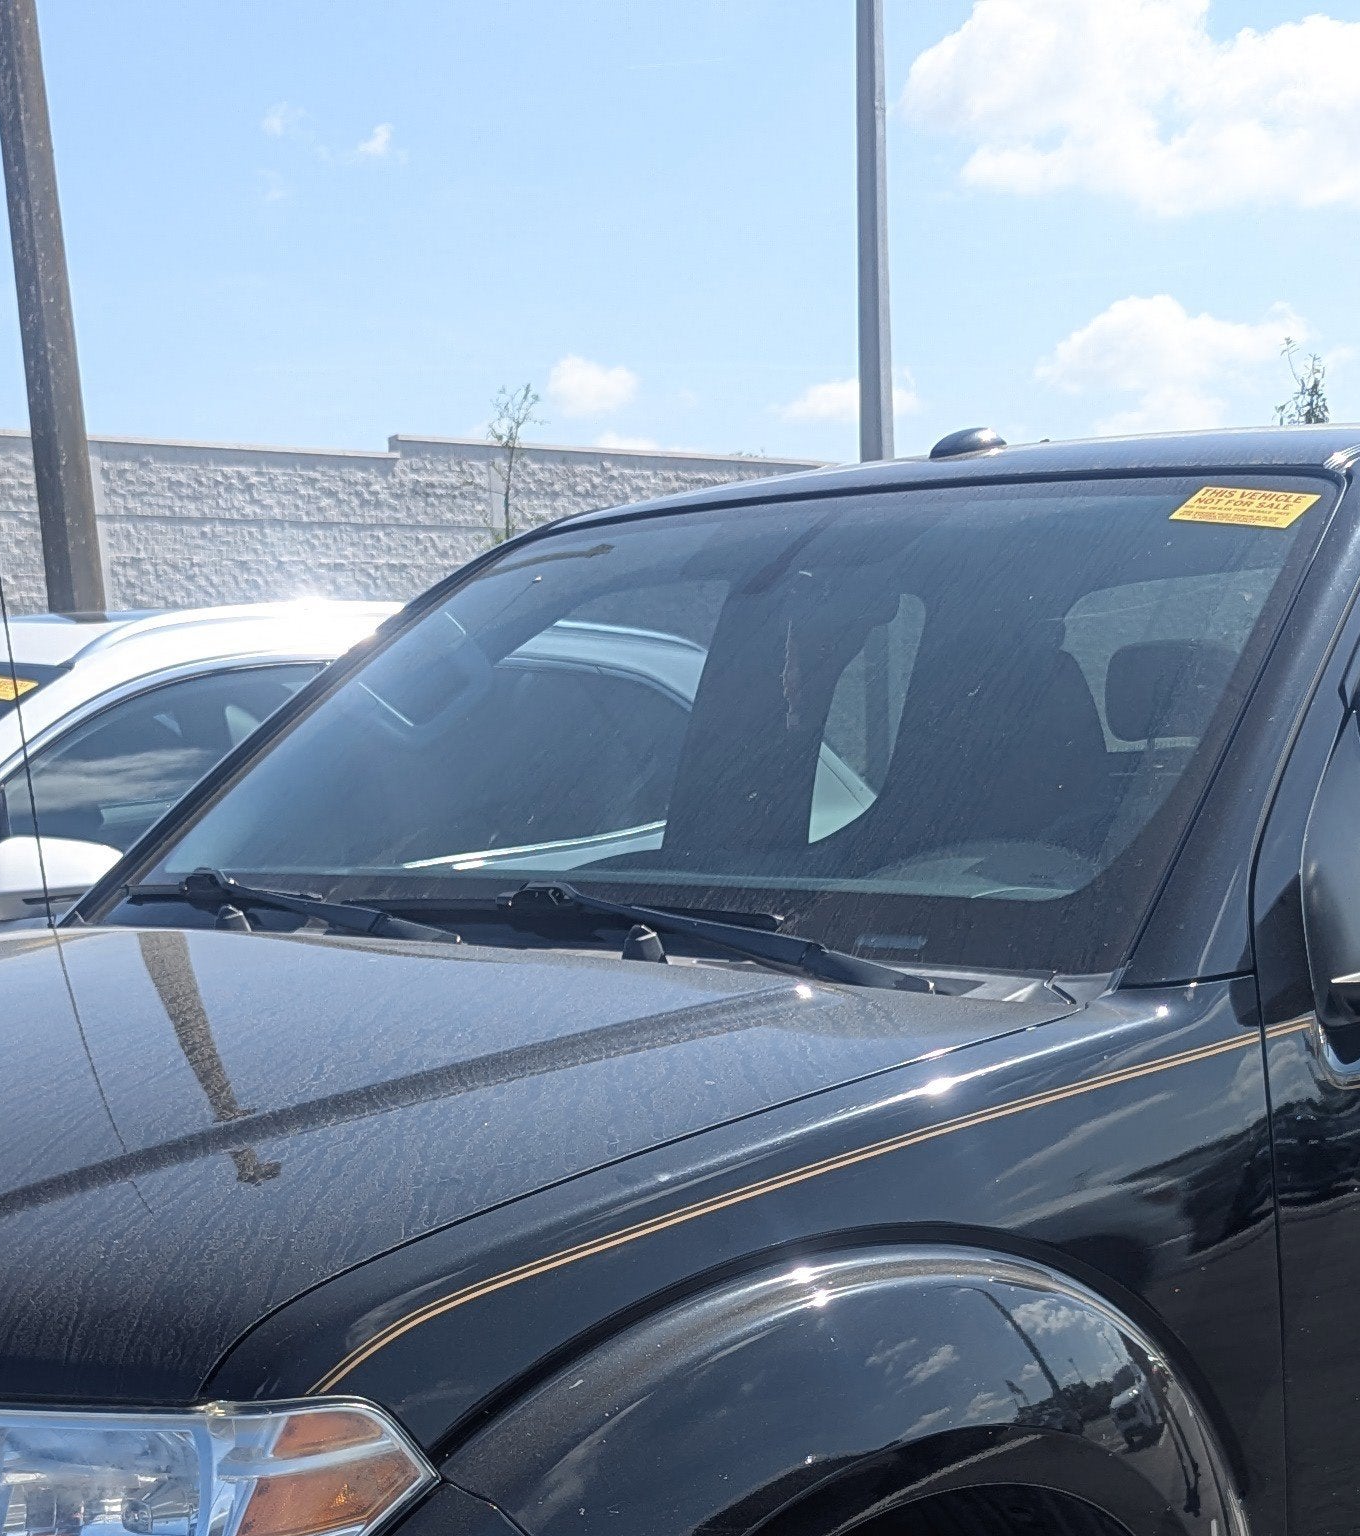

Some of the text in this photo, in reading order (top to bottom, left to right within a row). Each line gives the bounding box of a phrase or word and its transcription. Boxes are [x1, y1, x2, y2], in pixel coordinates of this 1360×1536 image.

[1200, 488, 1307, 504] THIS VEHICLE
[1194, 497, 1293, 511] NOT FOR SALE
